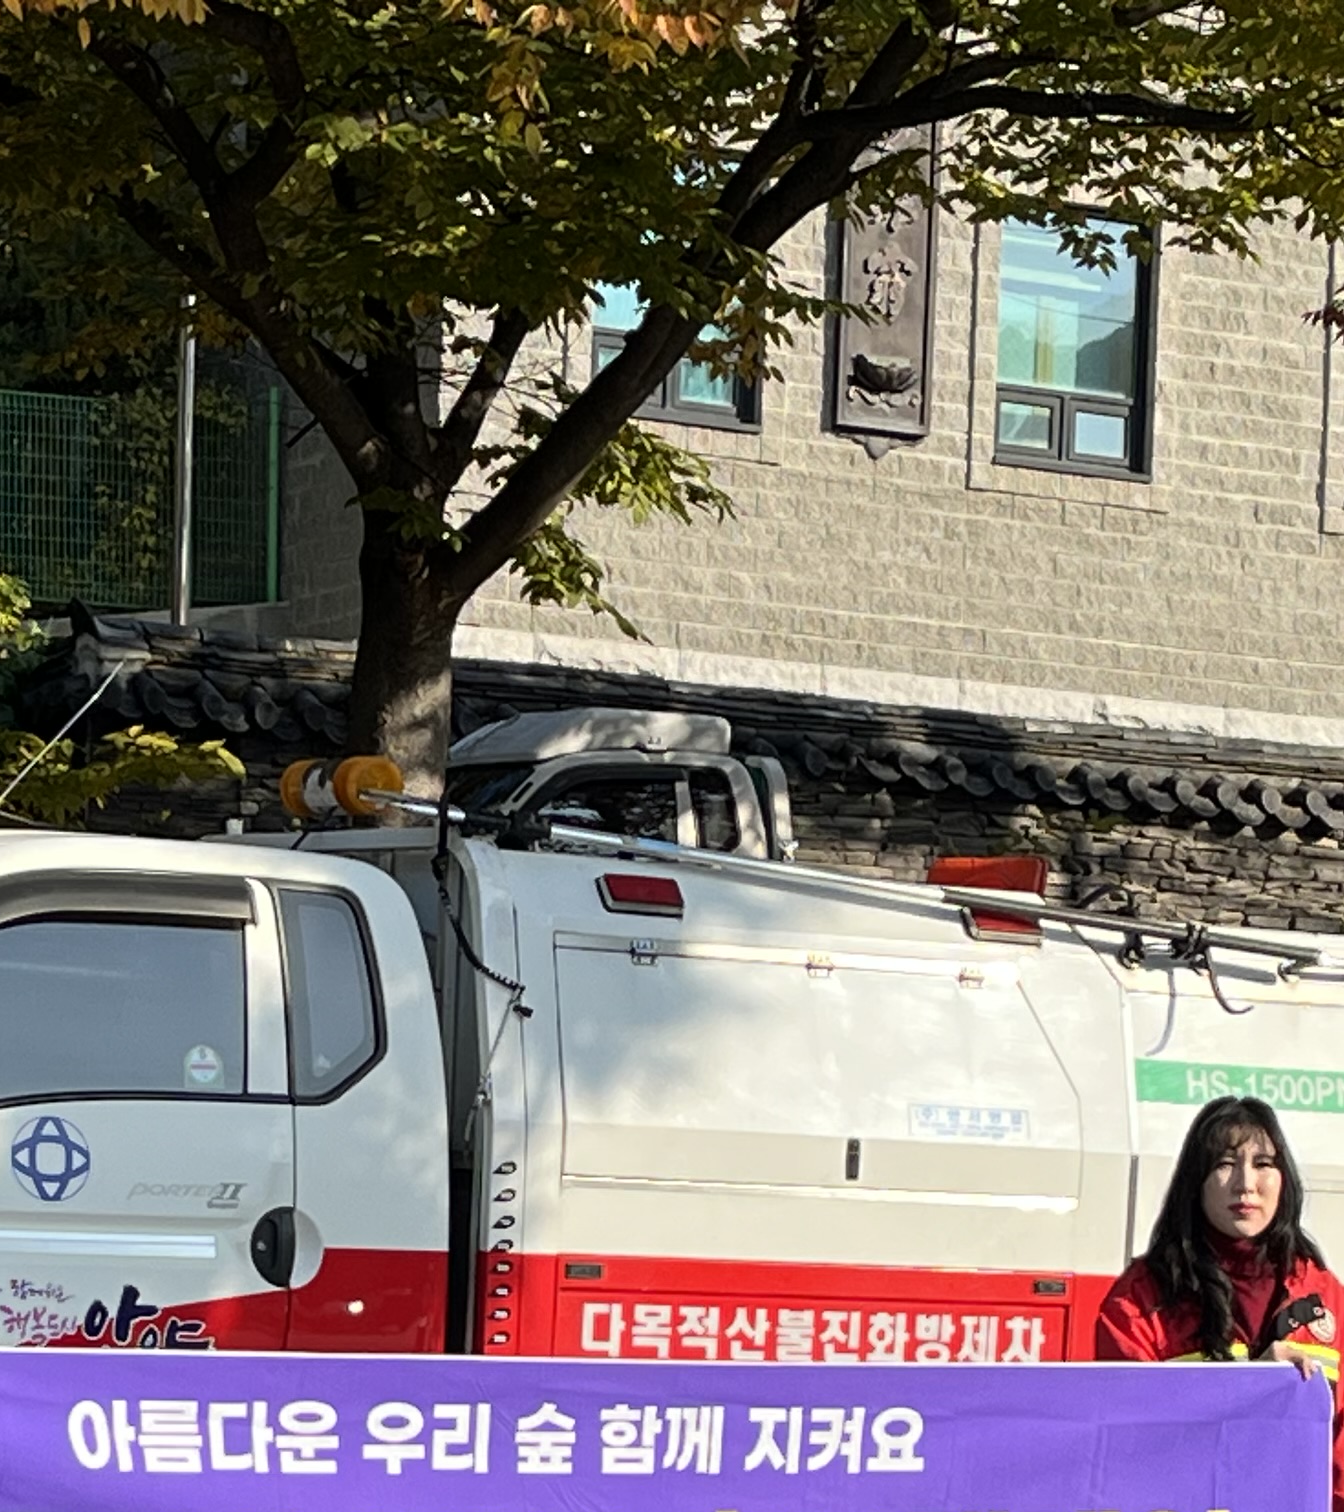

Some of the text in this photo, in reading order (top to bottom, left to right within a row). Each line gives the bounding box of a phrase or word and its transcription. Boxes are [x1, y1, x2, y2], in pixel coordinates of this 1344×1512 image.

[67, 1399, 925, 1475] 아름다운 우리 숲 함께 지켜요
